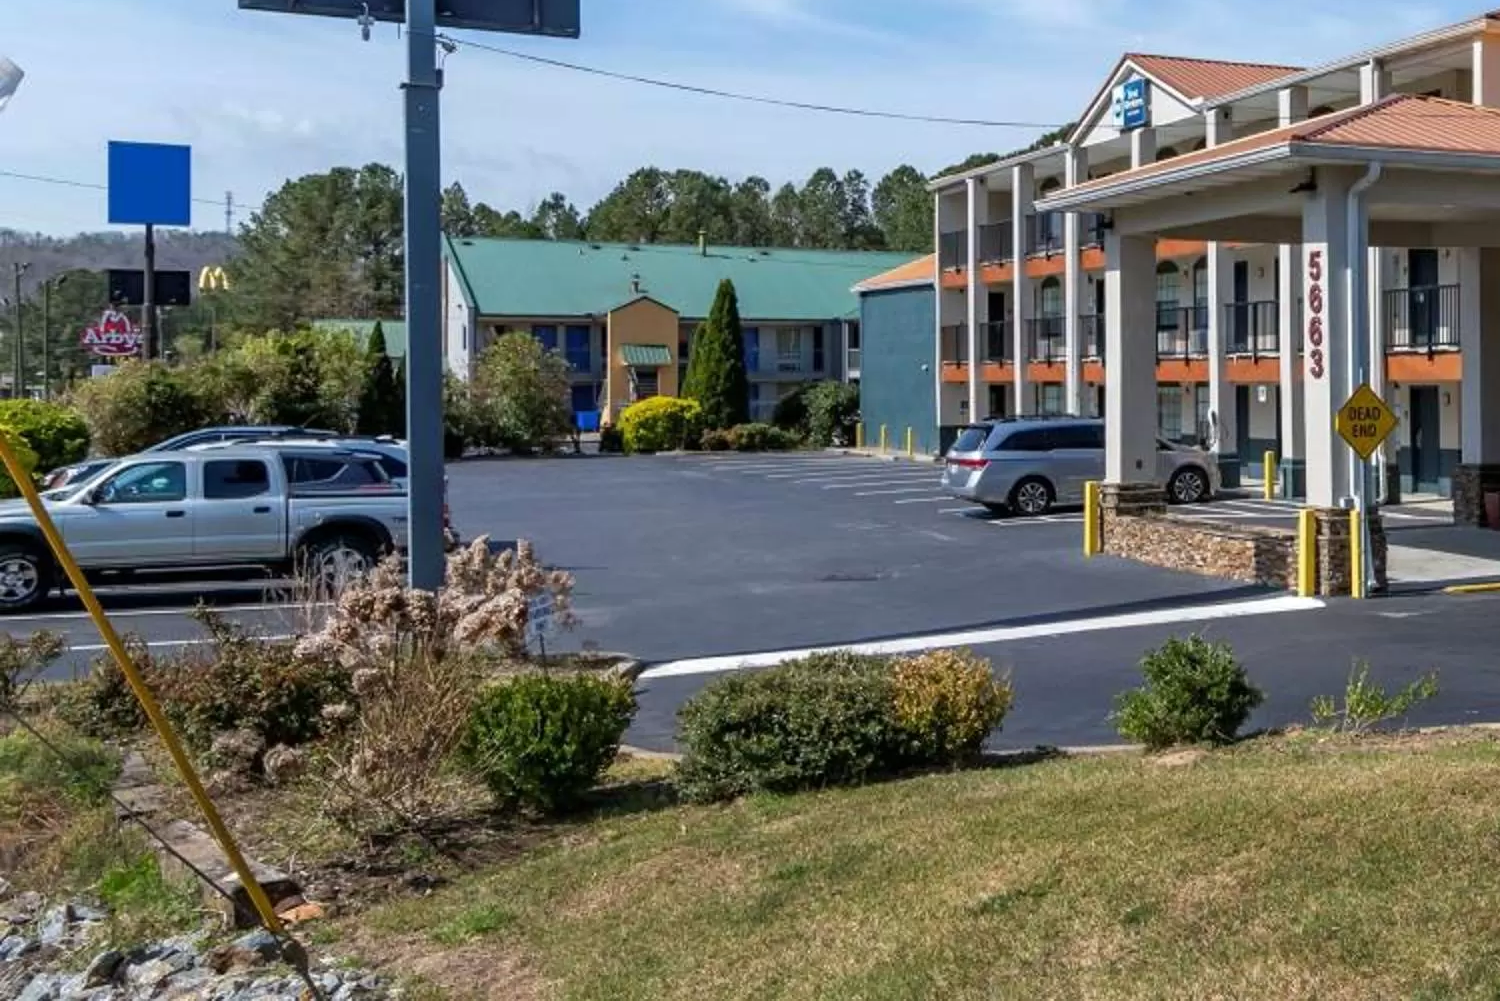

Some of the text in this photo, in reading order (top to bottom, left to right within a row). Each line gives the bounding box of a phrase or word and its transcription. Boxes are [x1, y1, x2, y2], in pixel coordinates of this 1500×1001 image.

[1308, 250, 1325, 379] 5663
[1349, 406, 1381, 422] DEAD
[1352, 426, 1377, 439] END
